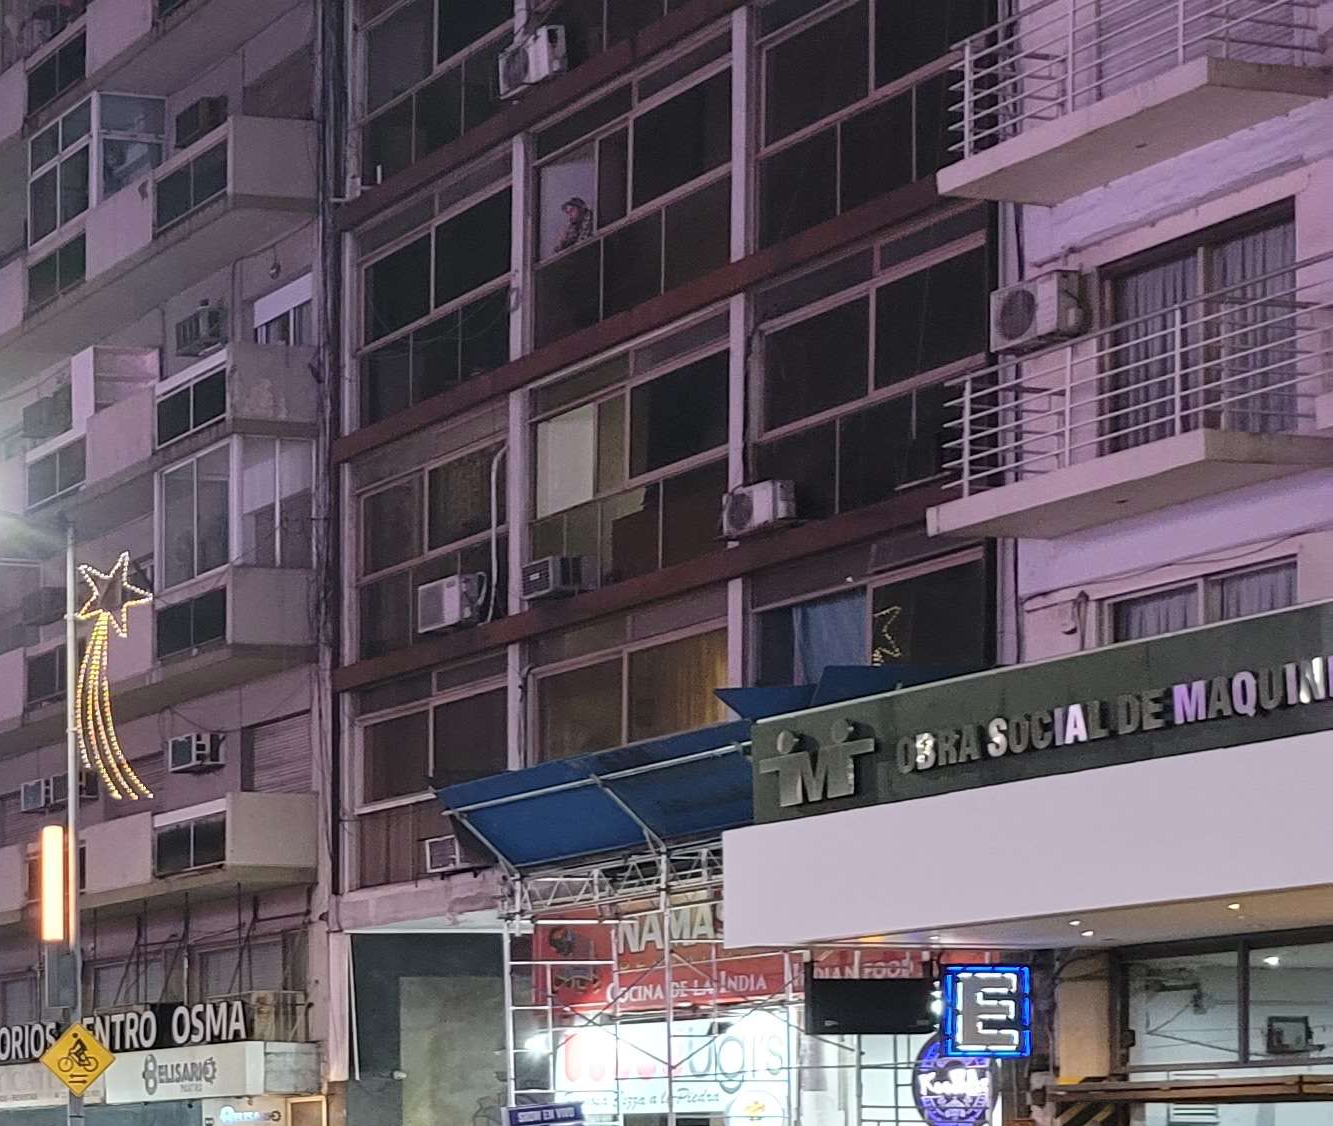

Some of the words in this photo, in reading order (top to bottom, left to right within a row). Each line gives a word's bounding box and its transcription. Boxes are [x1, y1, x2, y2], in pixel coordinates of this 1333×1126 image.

[896, 728, 980, 776] OBRA
[987, 703, 1110, 758] SOCIAL
[1118, 687, 1165, 737] DE
[1172, 654, 1333, 727] MAQUIN
[606, 981, 664, 1002] COCINA
[720, 970, 767, 994] INDIA
[955, 972, 1019, 1051] E
[171, 1000, 247, 1044] OSMA
